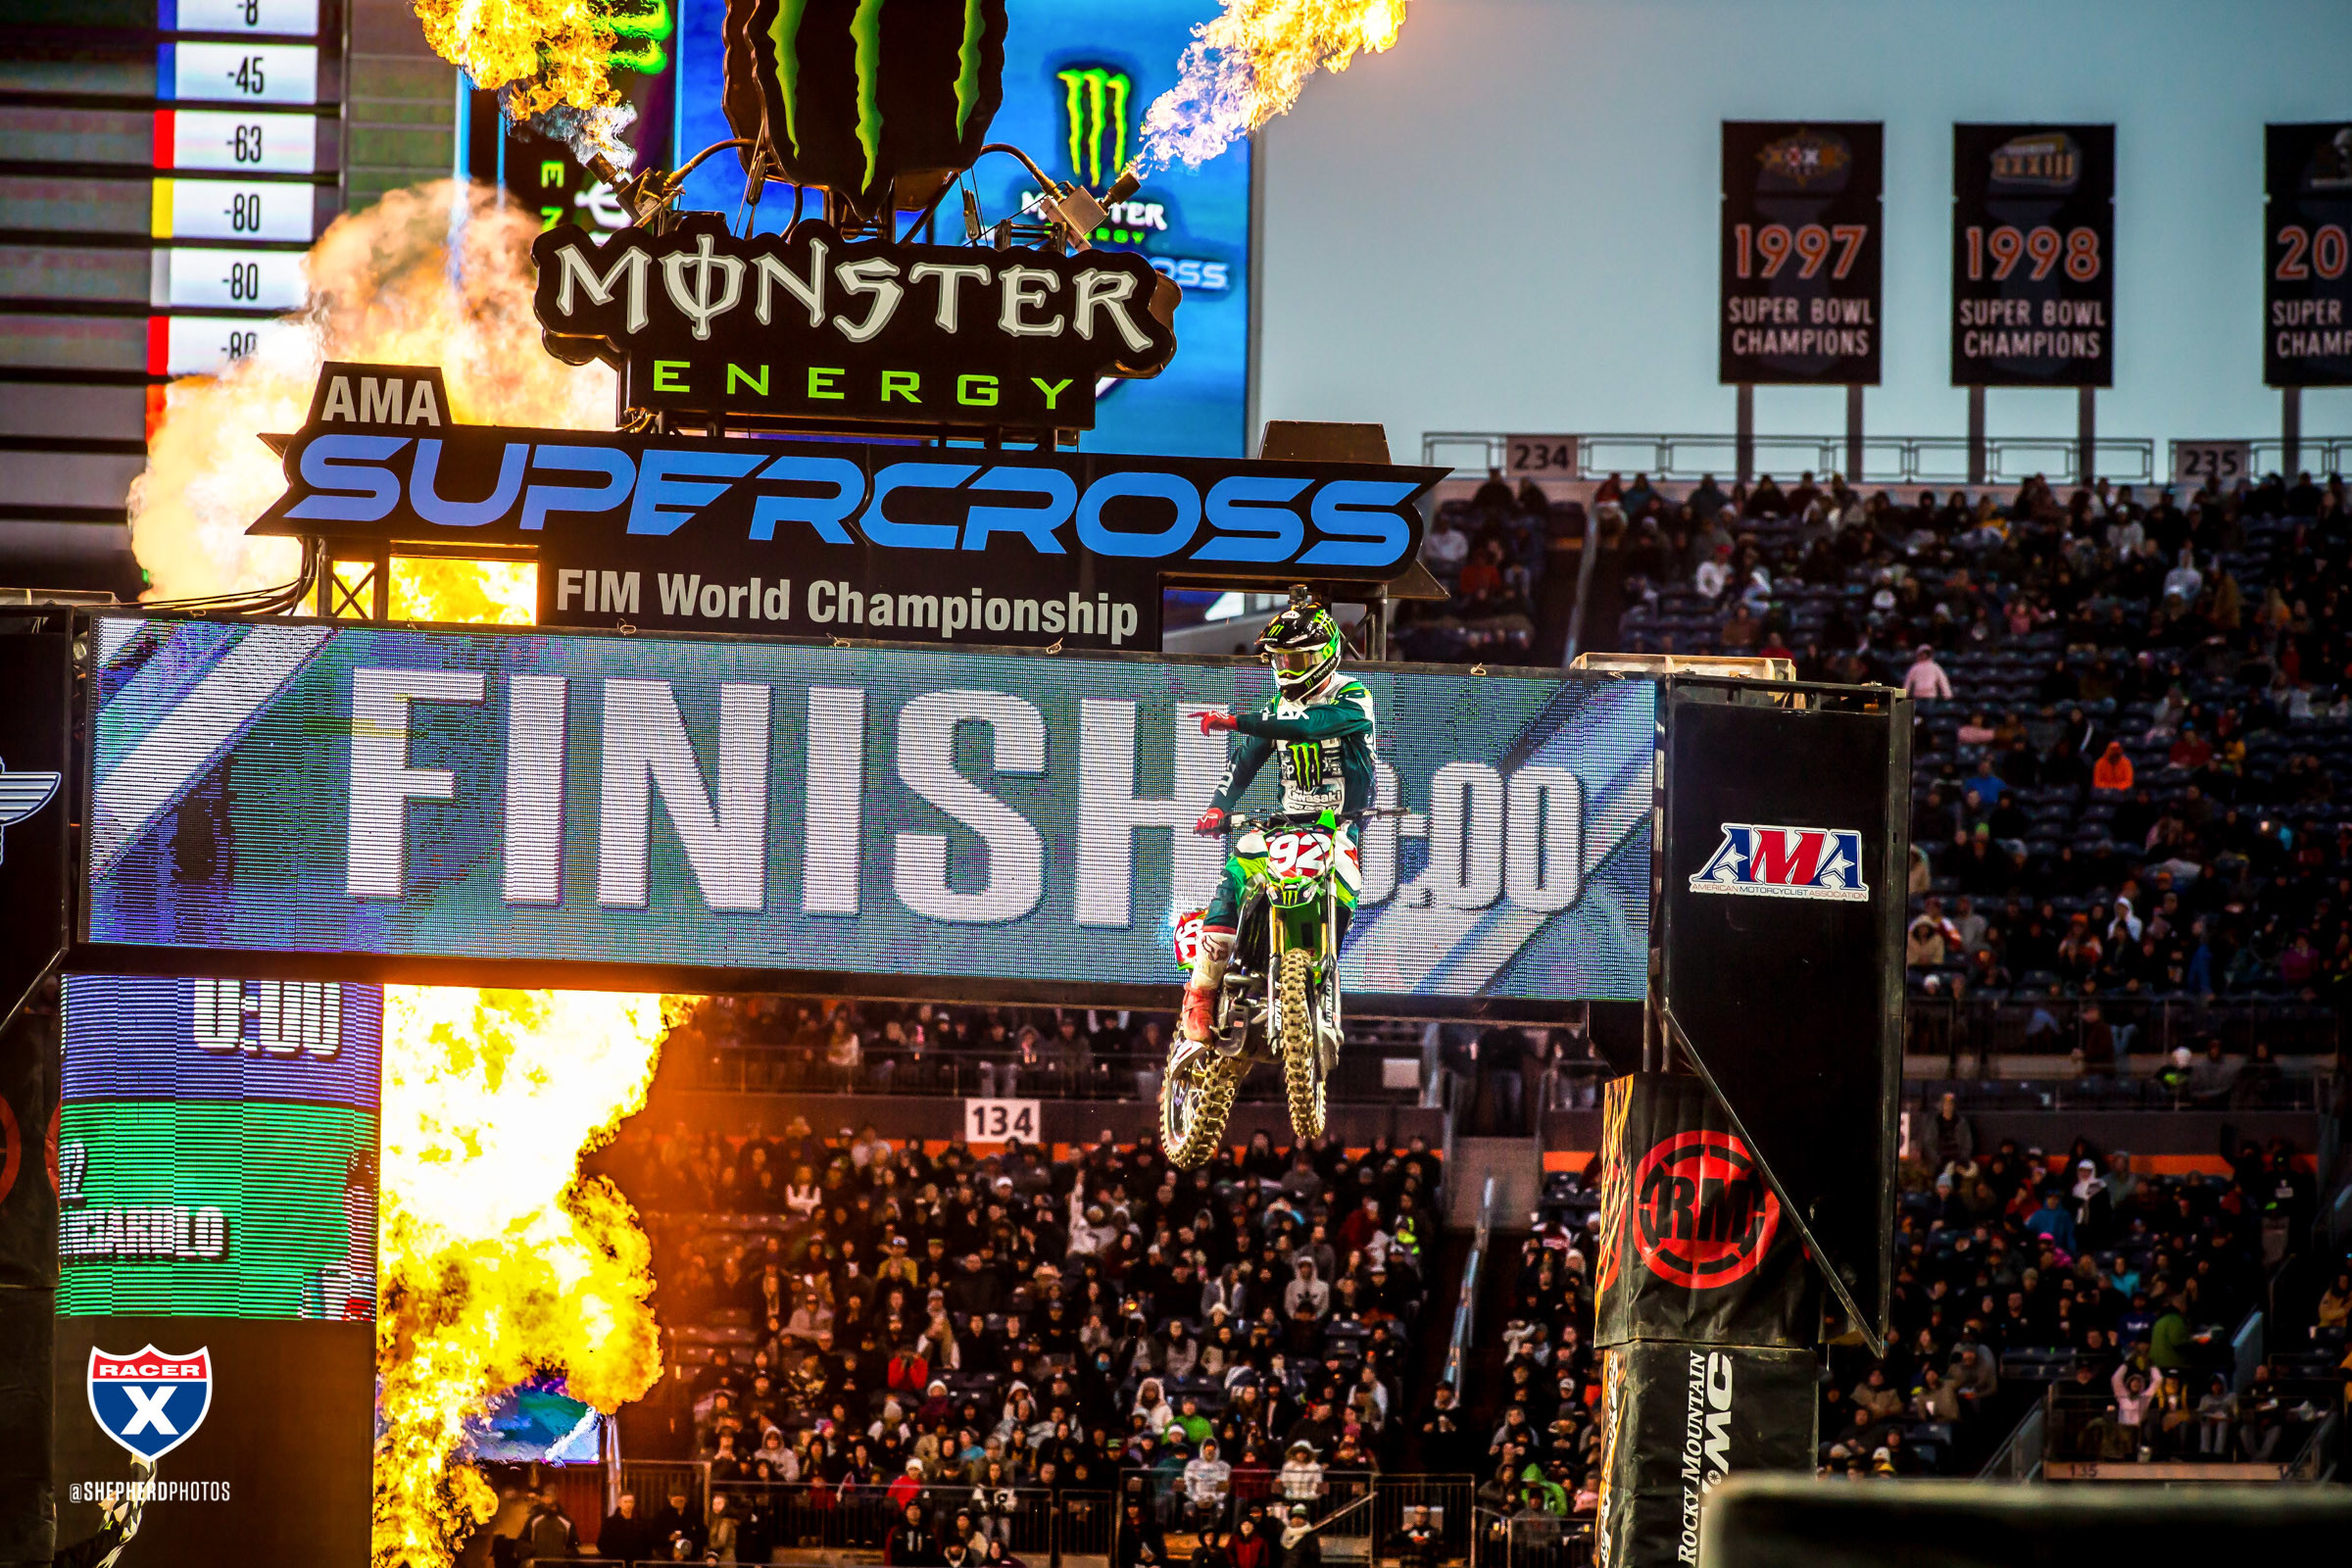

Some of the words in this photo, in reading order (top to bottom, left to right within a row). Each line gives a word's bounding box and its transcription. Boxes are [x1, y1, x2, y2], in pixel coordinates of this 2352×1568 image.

[227, 56, 264, 94] -45
[225, 124, 262, 163] -63
[223, 194, 261, 232] -80
[1736, 224, 1867, 279] 1997
[1967, 226, 2100, 281] 1998
[221, 263, 259, 301] -80
[555, 234, 1153, 353] MONSTER
[1729, 296, 1799, 324] SUPER
[1810, 298, 1874, 324] BOWL
[1960, 299, 2031, 326] SUPER
[2042, 299, 2106, 326] BOWL
[2273, 299, 2342, 326] SUPER
[1733, 328, 1869, 356] CHAMPIONS
[1964, 329, 2101, 358] CHAMPIONS
[321, 375, 441, 426] AMA
[654, 360, 1074, 410] ENERGY
[1514, 444, 1569, 469] 234
[2184, 450, 2238, 476] 235
[283, 434, 1421, 566] SUPERCROSS
[558, 568, 640, 614] FIM
[658, 573, 791, 620] World
[807, 579, 1138, 644] Championship
[346, 667, 1229, 928] FINISH
[1268, 833, 1332, 873] 92
[1691, 823, 1867, 890] AMA
[1692, 884, 1739, 893] AMERICAN
[1740, 886, 1808, 897] MOTORCYCLIST
[1809, 890, 1867, 900] ASSOCIATION
[972, 1105, 1033, 1137] 134
[1682, 1350, 1705, 1485] MOUNTAIN
[1678, 1486, 1699, 1568] ROCKY
